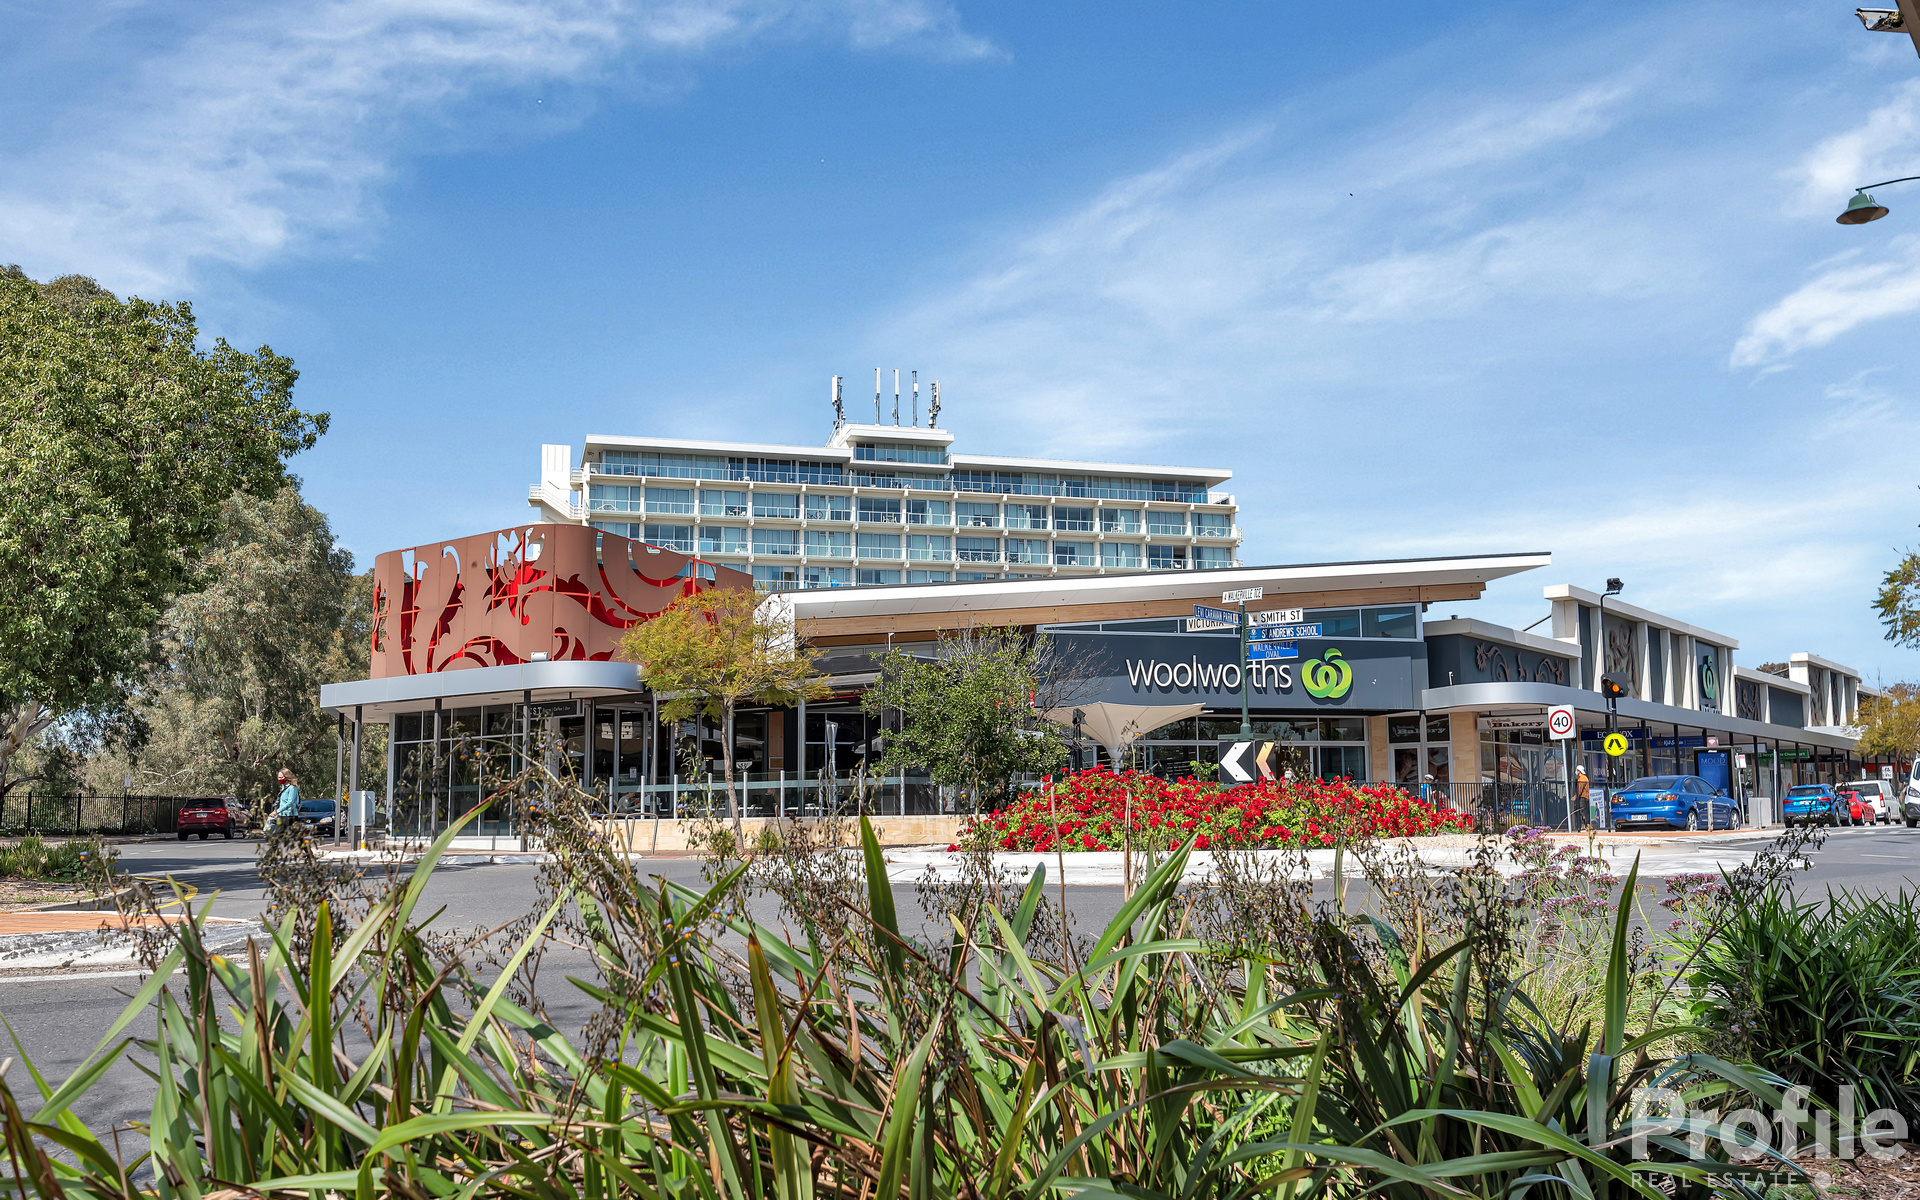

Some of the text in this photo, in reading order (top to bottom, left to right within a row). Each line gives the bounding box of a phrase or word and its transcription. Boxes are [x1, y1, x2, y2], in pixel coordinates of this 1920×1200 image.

[1228, 588, 1253, 600] WALKERVILLE
[1195, 607, 1233, 623] LEVI CARAVAN PARK
[1260, 610, 1301, 623] SMITH ST
[1268, 627, 1294, 638] ANDREWS
[1296, 625, 1318, 637] SCHOOL
[1252, 641, 1294, 652] WALKERVILLE
[1265, 650, 1281, 659] OVAL
[1553, 716, 1568, 728] 40
[1523, 731, 1541, 739] Bakery
